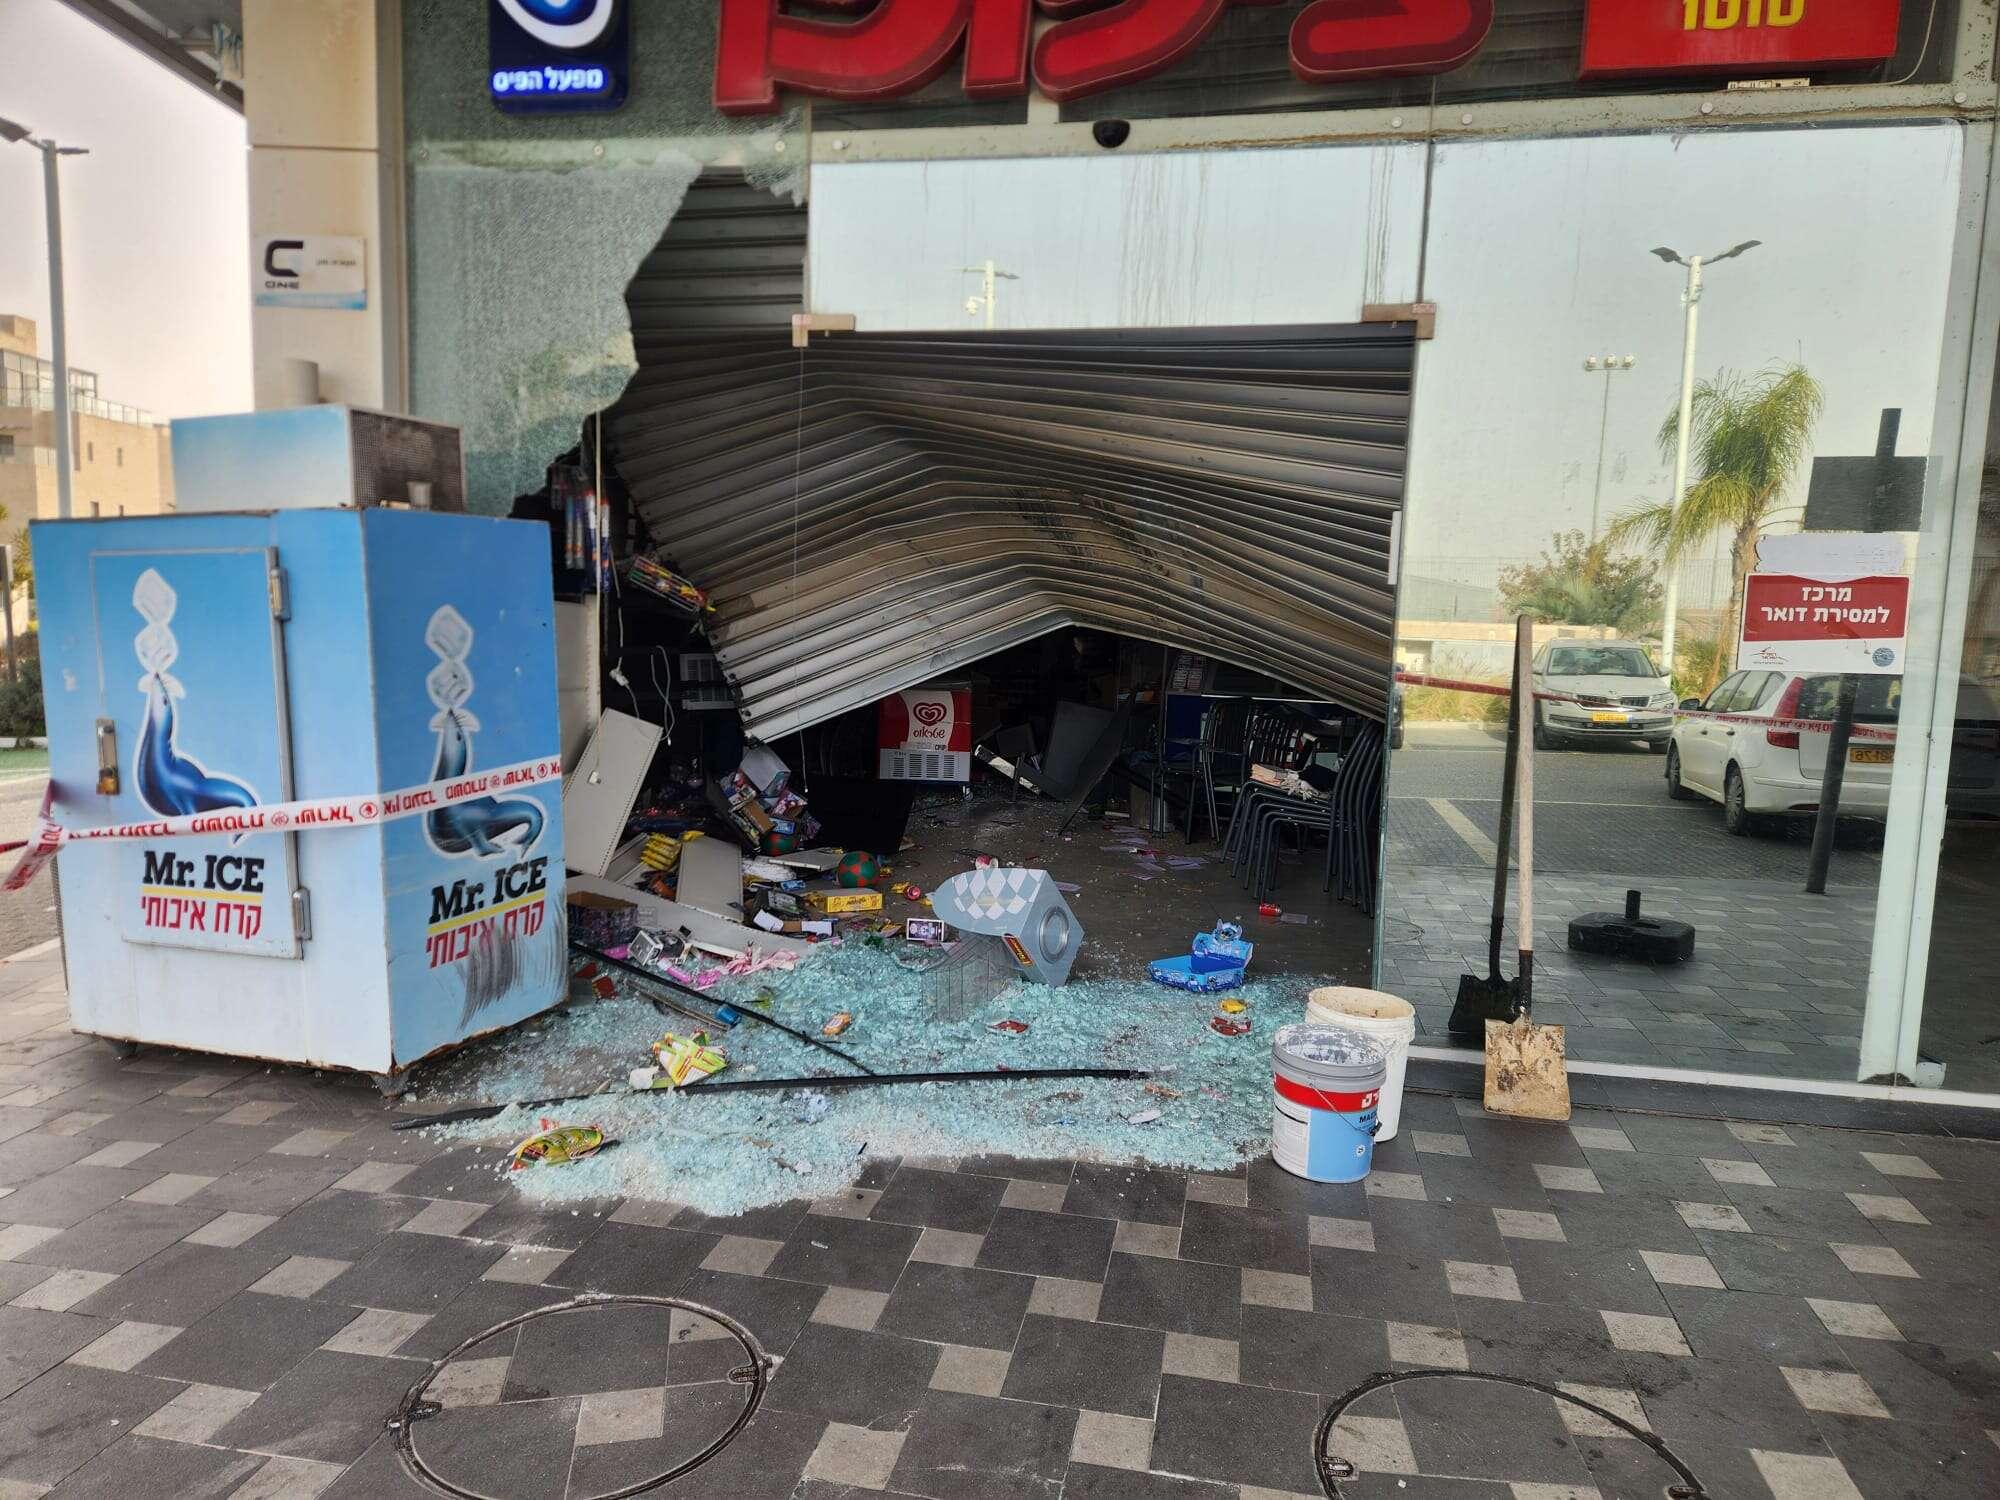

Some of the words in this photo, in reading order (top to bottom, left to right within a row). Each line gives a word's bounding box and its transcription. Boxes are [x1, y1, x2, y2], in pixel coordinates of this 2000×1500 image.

[493, 70, 544, 92] הפיס
[544, 66, 604, 91] מפעל
[264, 281, 300, 290] ONE
[1801, 586, 1853, 602] מרכז
[1760, 606, 1808, 622] דואר
[1812, 605, 1891, 624] למסירת
[191, 812, 265, 834] משטרת
[294, 805, 354, 824] ישראל
[383, 794, 400, 815] אין
[402, 790, 437, 811] מעבר
[445, 777, 488, 800] משטרת
[503, 767, 536, 786] ישראל
[142, 850, 196, 888] Mr.
[203, 854, 265, 893] ICE
[428, 878, 485, 925] Mr.
[492, 855, 548, 905] ICE
[141, 896, 206, 932] איכותי
[213, 902, 262, 940] קרח
[503, 899, 546, 944] קרח
[425, 916, 498, 969] איכותי
